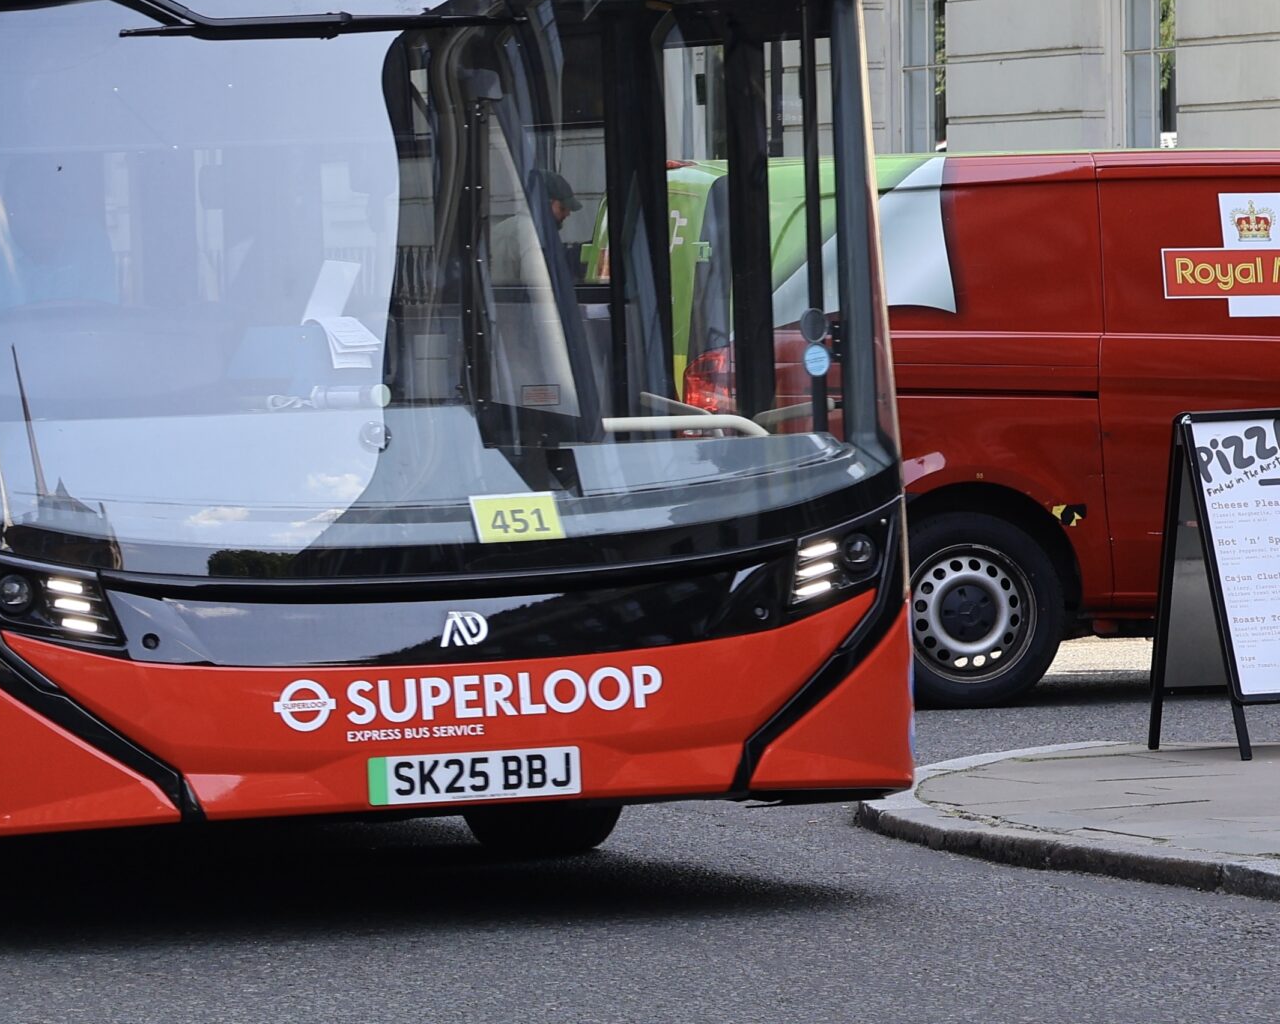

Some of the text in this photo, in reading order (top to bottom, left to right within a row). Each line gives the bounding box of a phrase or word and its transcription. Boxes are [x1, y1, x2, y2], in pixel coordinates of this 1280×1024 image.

[1175, 257, 1264, 291] Royal
[1196, 419, 1280, 483] Pizz
[1211, 501, 1249, 510] Cheese
[491, 507, 551, 534] 451
[1218, 538, 1237, 546] Hot
[1233, 616, 1265, 624] Roasty
[281, 701, 328, 710] SUPERLOOP
[346, 665, 663, 725] SUPERLOOP
[346, 724, 485, 743] EXPRESS BUS SERVICE
[394, 752, 571, 796] SK25 BBJ
